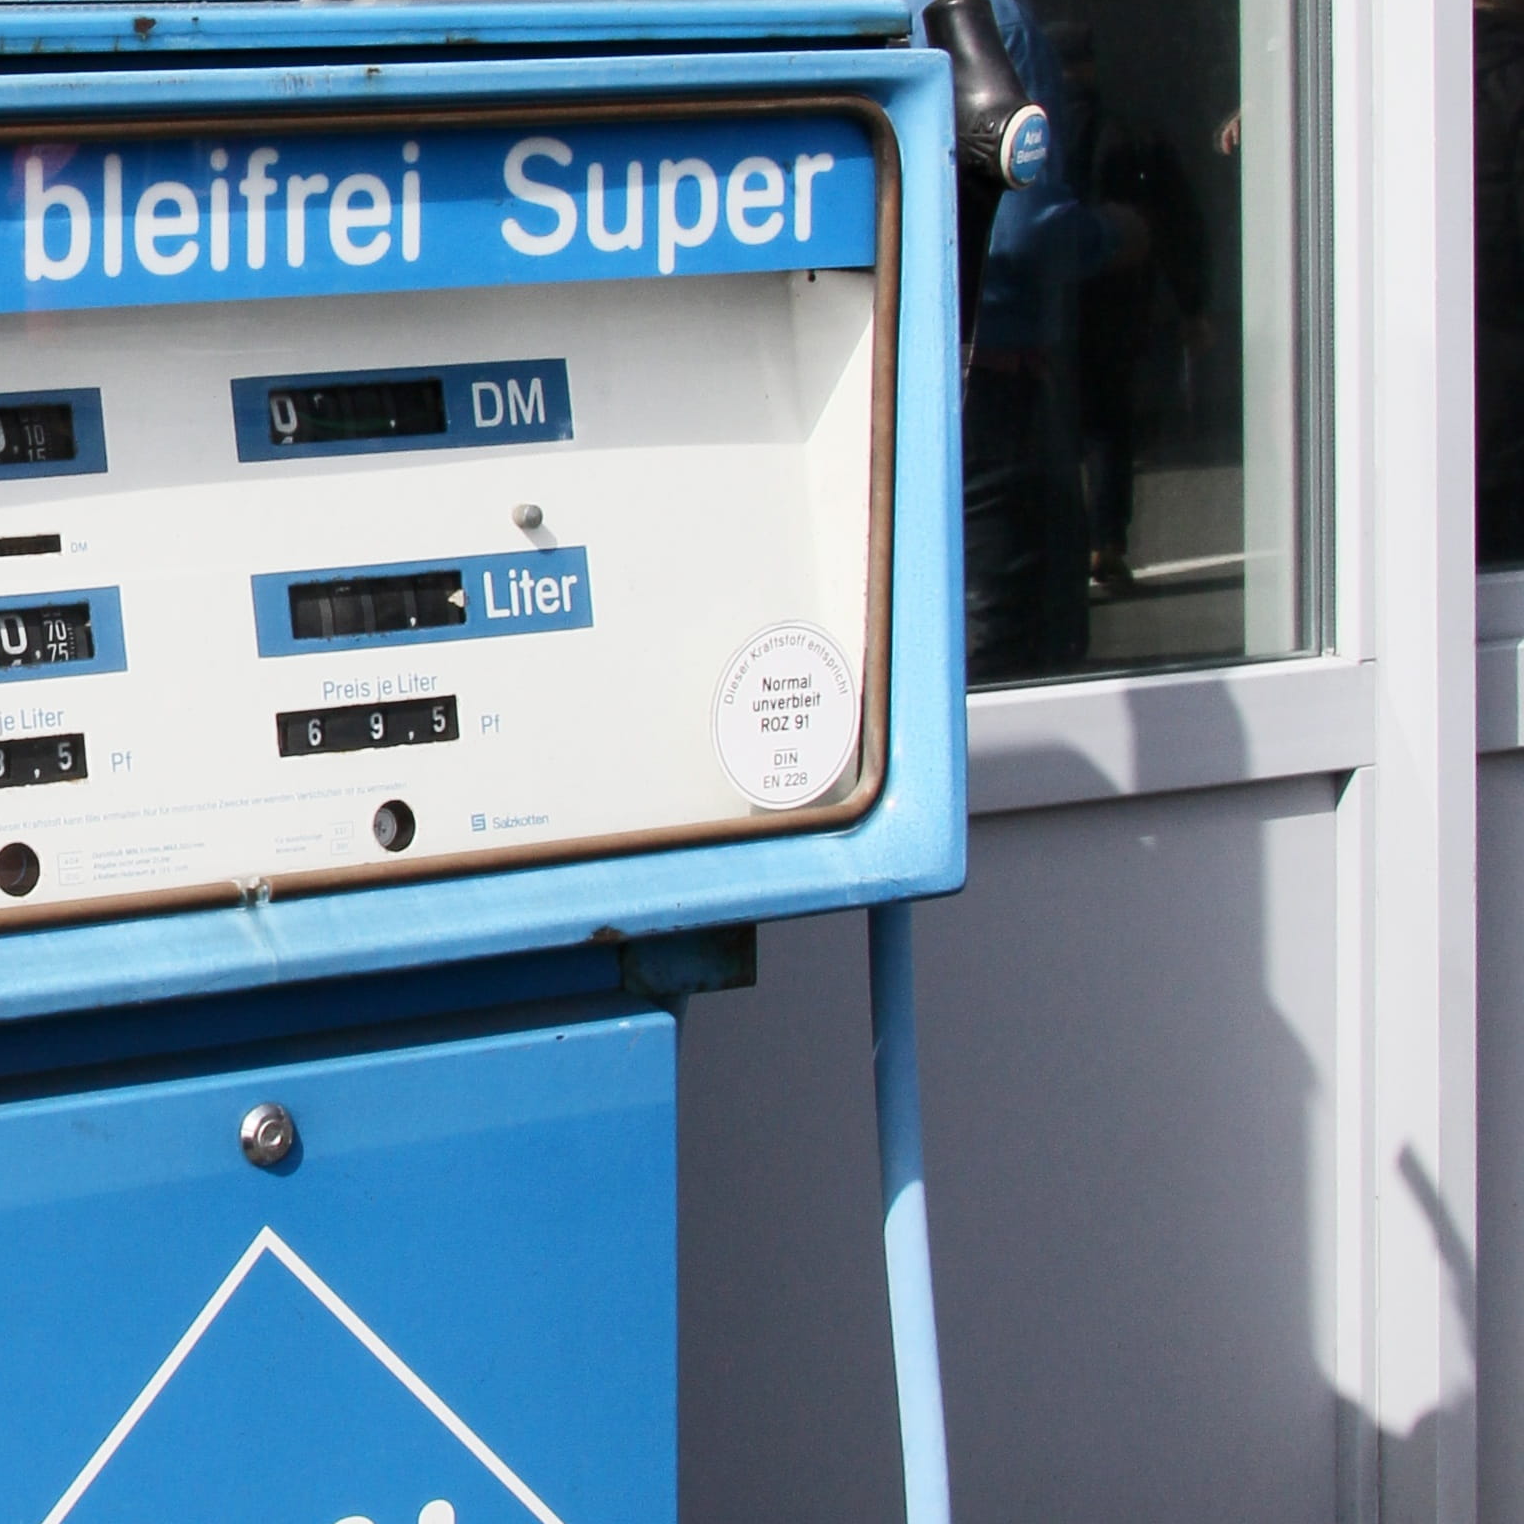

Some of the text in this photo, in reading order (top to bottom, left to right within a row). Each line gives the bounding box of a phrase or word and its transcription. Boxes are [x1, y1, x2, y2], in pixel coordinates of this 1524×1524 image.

[24, 152, 420, 283] bleifrei
[501, 136, 833, 275] Super
[472, 378, 546, 428] DM
[483, 568, 577, 620] Liter
[724, 634, 849, 705] Dieser Kraftstoff entspricht
[322, 673, 438, 702] Preis je Liter
[762, 674, 812, 692] Normal
[753, 692, 820, 712] unverbleit
[20, 709, 64, 731] Liter
[481, 715, 500, 734] Pf
[761, 715, 809, 733] ROZ 91
[111, 751, 132, 773] Pf
[774, 752, 798, 766] DIN
[764, 772, 808, 789] EN 228
[492, 813, 549, 831] Salzkotten
